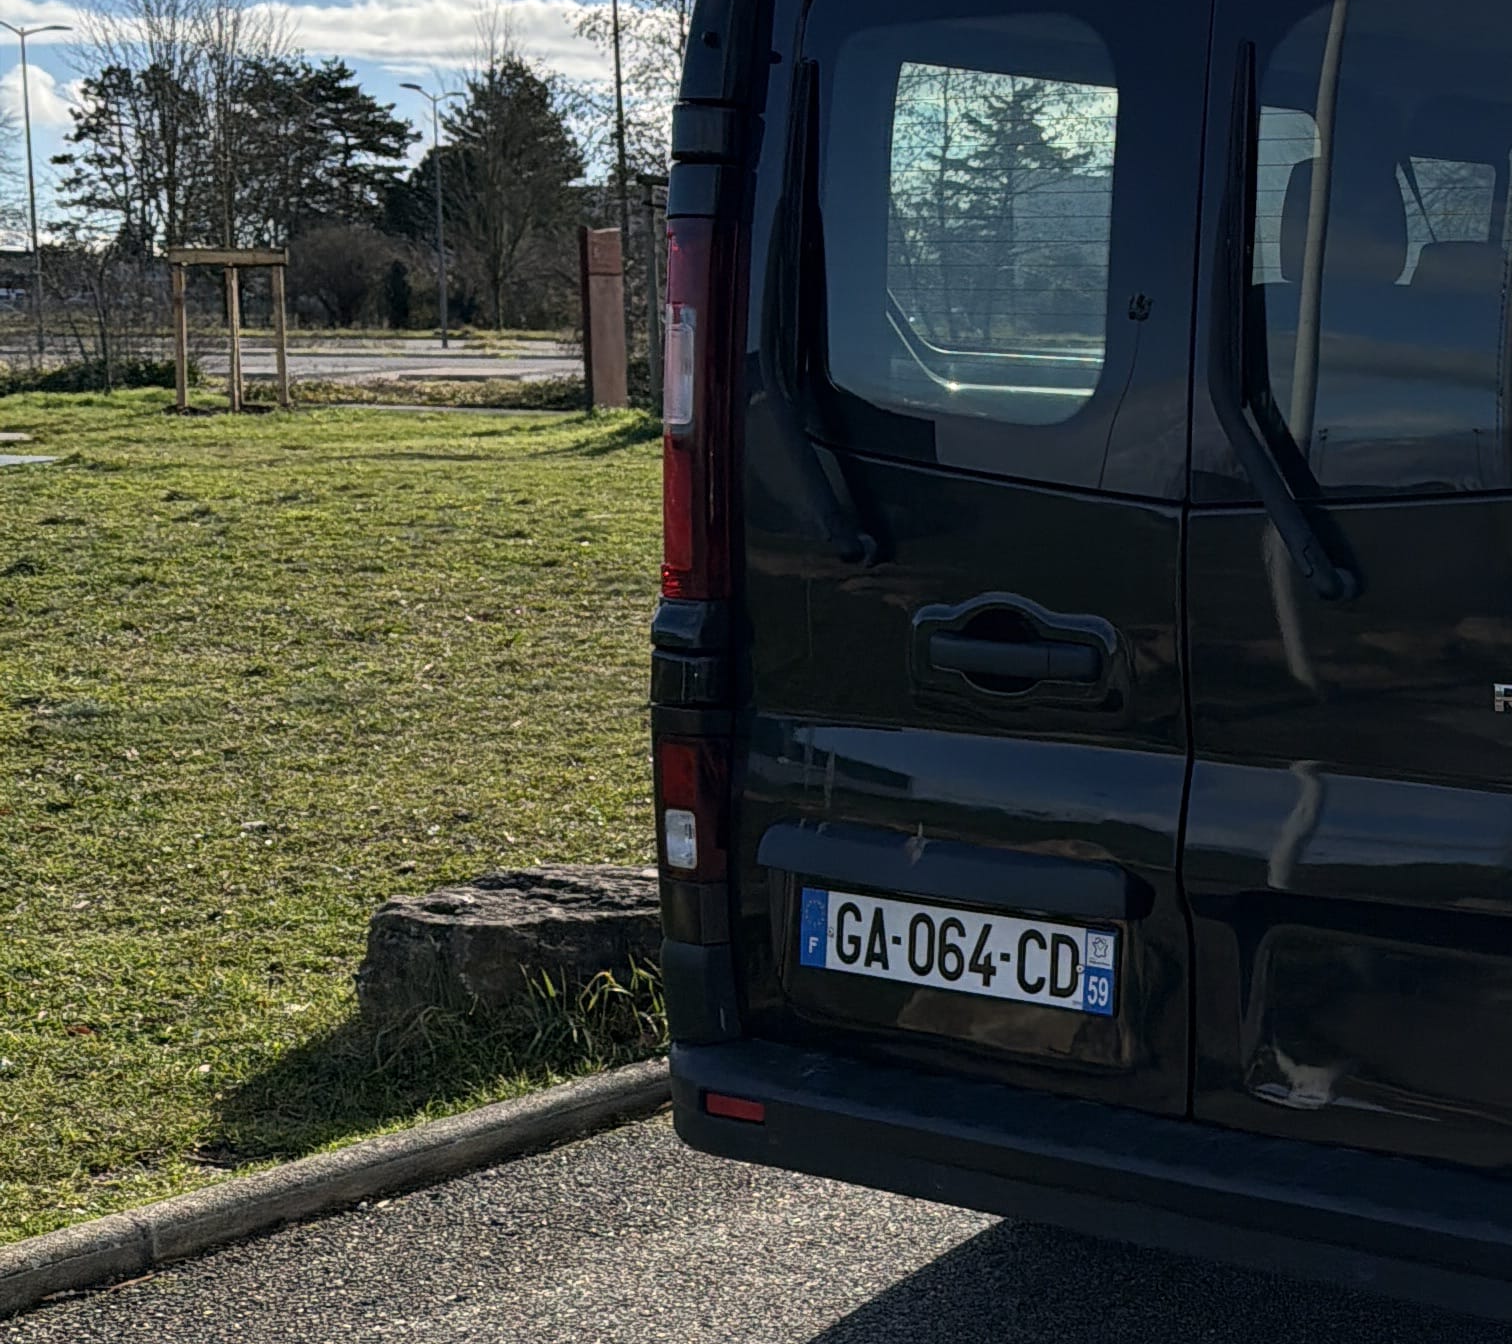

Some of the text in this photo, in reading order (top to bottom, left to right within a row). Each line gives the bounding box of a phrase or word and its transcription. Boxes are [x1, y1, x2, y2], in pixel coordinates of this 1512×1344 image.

[808, 936, 819, 954] F
[836, 902, 1080, 998] GA-064-CD
[1087, 976, 1109, 1006] 59
